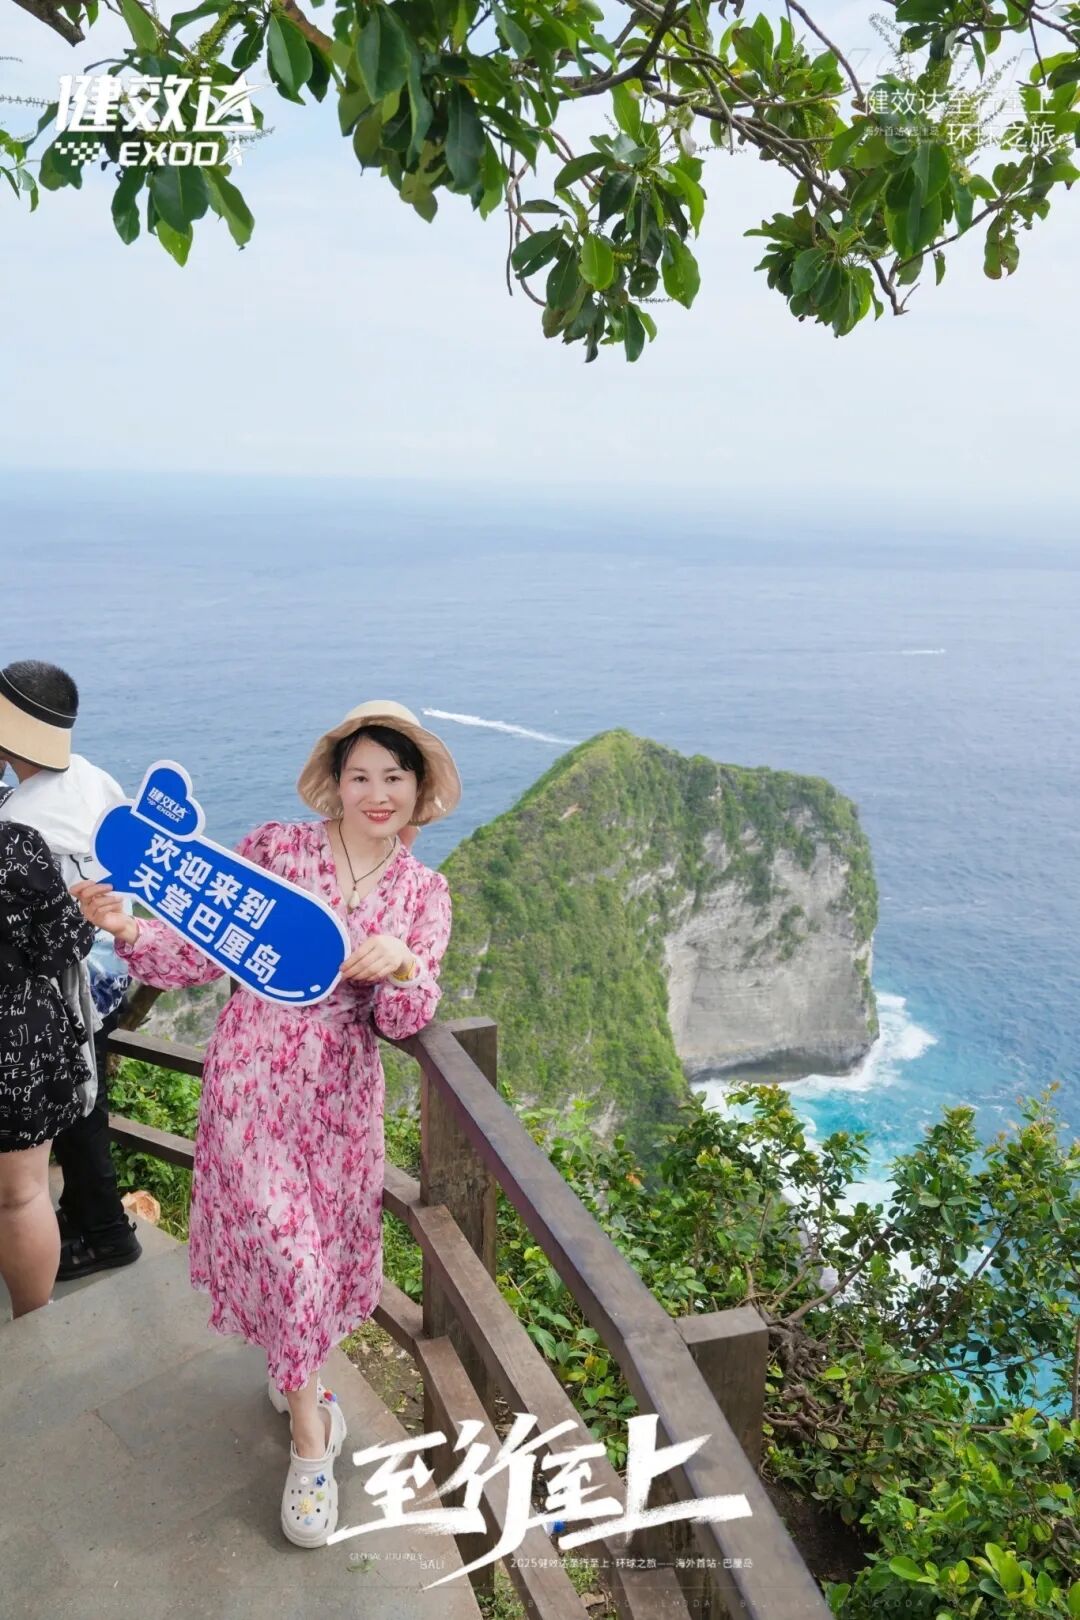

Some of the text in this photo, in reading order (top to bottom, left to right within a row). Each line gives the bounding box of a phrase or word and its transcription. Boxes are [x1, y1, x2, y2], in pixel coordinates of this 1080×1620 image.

[128, 863, 282, 984] 天堂巴厘岛
[145, 833, 277, 931] 欢迎来到
